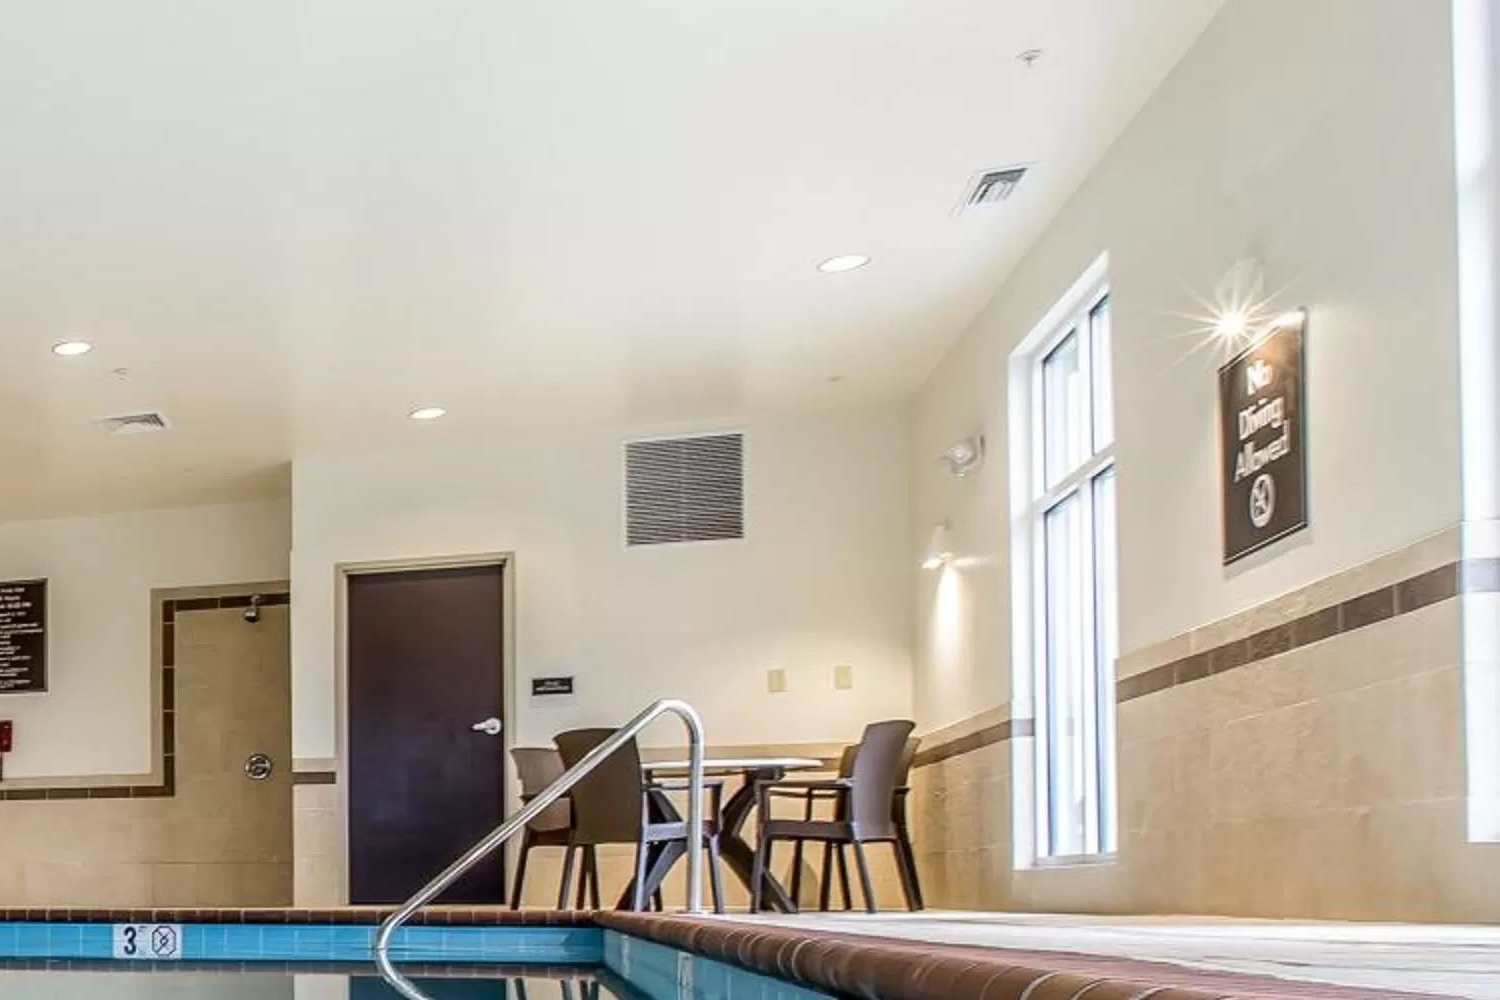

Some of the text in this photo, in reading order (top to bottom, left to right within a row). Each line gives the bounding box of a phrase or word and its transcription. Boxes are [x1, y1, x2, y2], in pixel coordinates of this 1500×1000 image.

[1247, 360, 1273, 395] No
[1239, 397, 1285, 440] Diving
[1234, 420, 1290, 482] Allowed
[124, 926, 137, 955] 3
